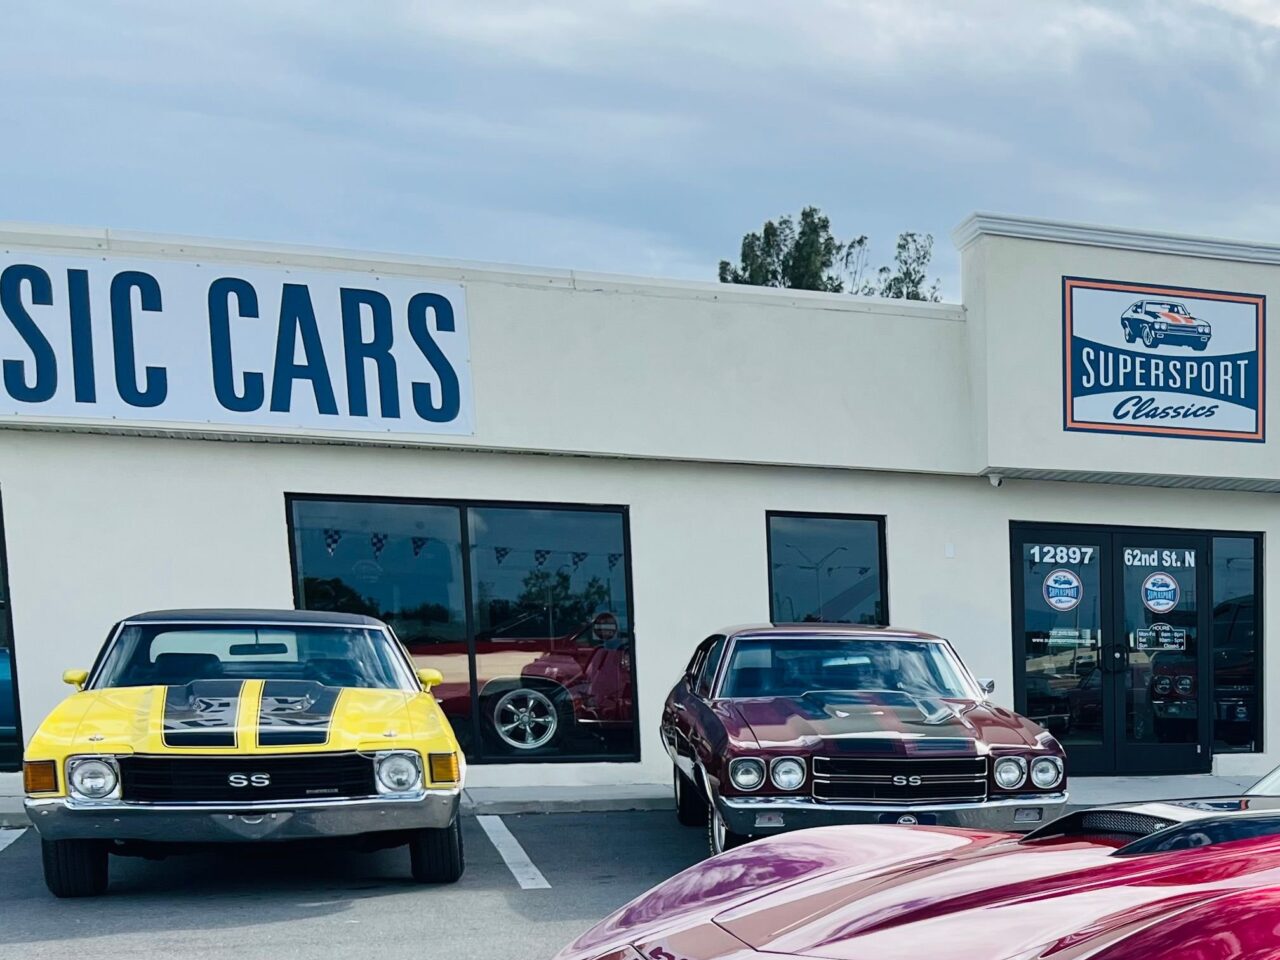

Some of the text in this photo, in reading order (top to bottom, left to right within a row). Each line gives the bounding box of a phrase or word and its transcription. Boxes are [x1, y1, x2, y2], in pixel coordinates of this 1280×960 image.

[208, 277, 461, 423] CARS
[1082, 347, 1248, 398] SUPERSPORT
[1113, 396, 1219, 420] Classics
[1030, 545, 1093, 564] 12897
[1124, 549, 1195, 567] 62nd St. N
[228, 774, 270, 787] SS
[893, 775, 922, 786] SS
